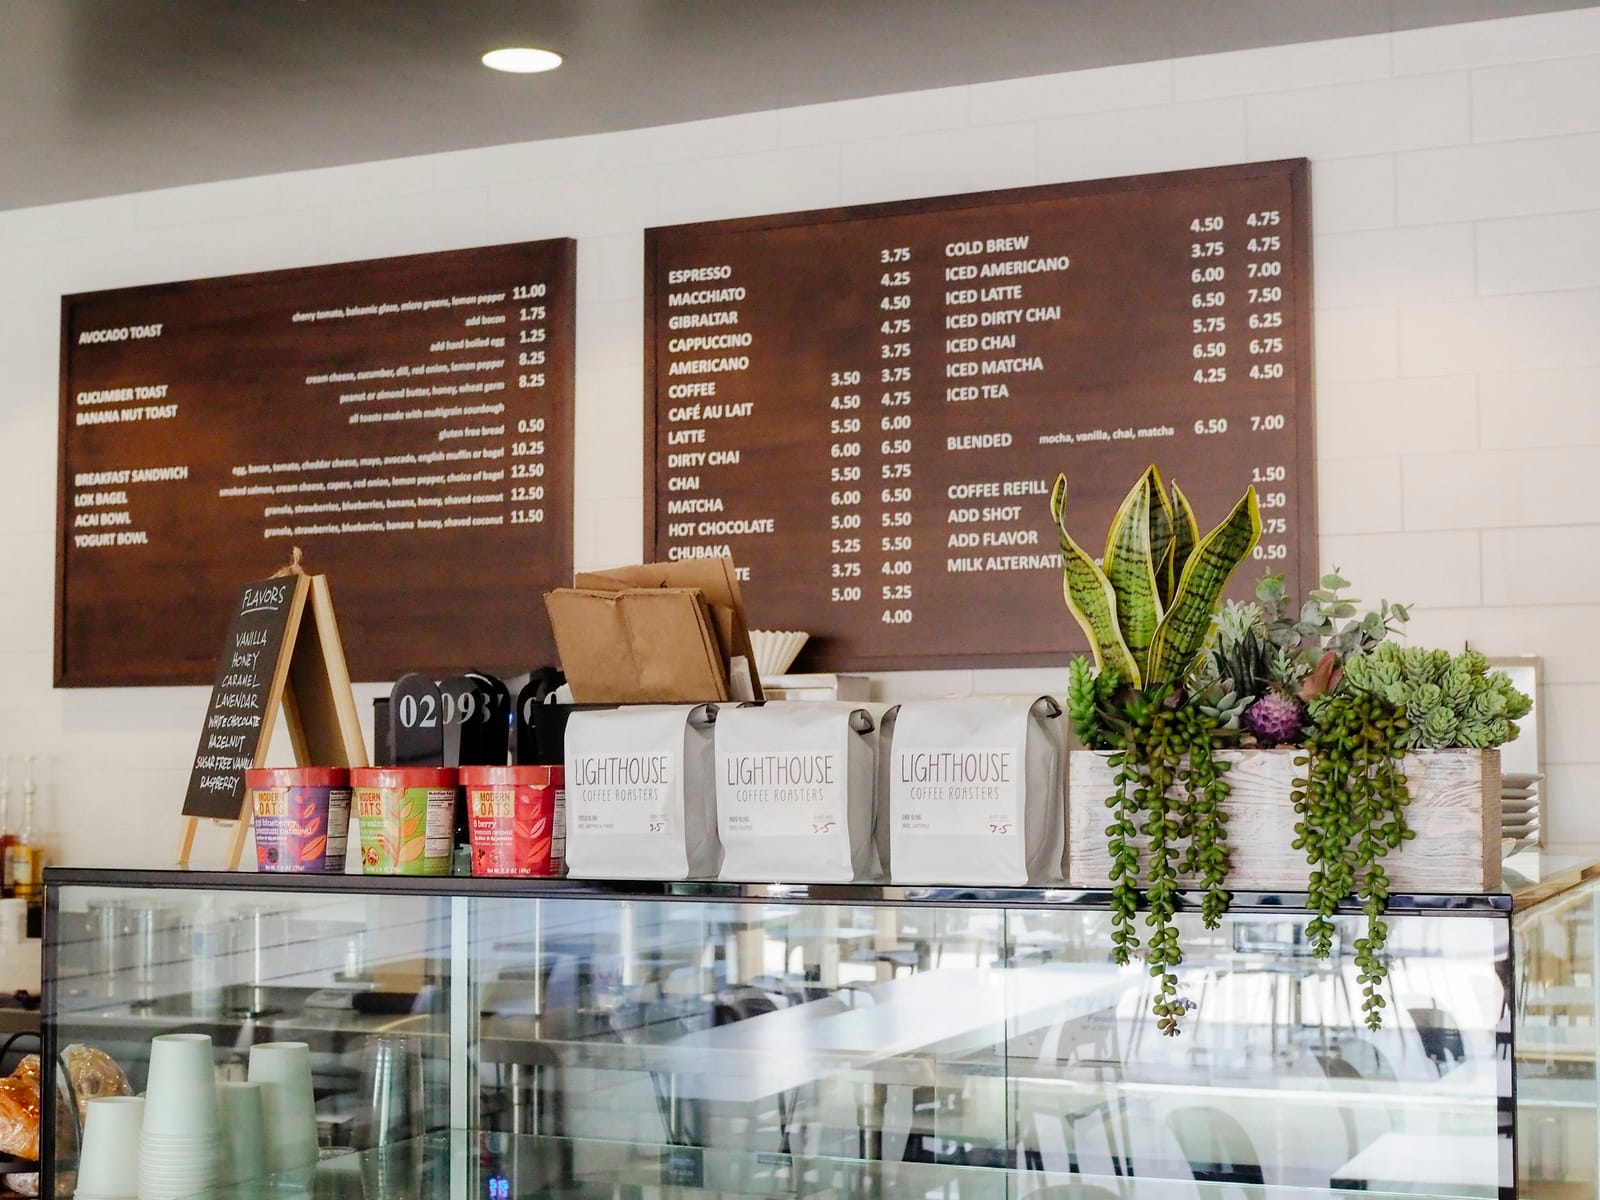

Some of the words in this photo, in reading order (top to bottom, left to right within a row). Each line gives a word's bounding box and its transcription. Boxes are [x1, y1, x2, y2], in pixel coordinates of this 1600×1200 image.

[1191, 217, 1223, 232] 4.50
[1247, 211, 1280, 226] 4.75
[946, 241, 983, 257] COLD
[987, 236, 1029, 253] BREW
[1192, 242, 1224, 257] 3.75
[1247, 236, 1280, 252] 4.75
[881, 248, 910, 263] 3.75
[669, 266, 731, 284] ESPRESSO
[946, 266, 977, 281] ICED
[980, 256, 1069, 277] AMERICANO
[1192, 267, 1224, 282] 6.00
[1248, 262, 1281, 278] 7.00
[881, 272, 910, 286] 4.25
[513, 284, 546, 300] 11.00
[669, 287, 745, 306] MACCHIATO
[946, 290, 977, 305] ICED
[981, 285, 1022, 302] LATTE
[1192, 292, 1225, 308] 6.50
[1248, 287, 1281, 303] 7.50
[520, 306, 545, 321] 1.75
[669, 311, 738, 329] GIBRALTAR
[946, 314, 978, 329] ICED
[981, 309, 1023, 326] DIRTY
[1026, 306, 1060, 322] CHAI
[881, 319, 910, 334] 4.75
[1193, 317, 1225, 333] 5.75
[1249, 312, 1282, 328] 6.25
[79, 328, 129, 344] AVOCADO
[130, 324, 162, 338] TOAST
[520, 329, 545, 343] 1.25
[669, 333, 752, 352] CAPPUCCINO
[882, 343, 911, 358] 3.75
[947, 338, 978, 353] ICED
[981, 335, 1015, 350] CHAI
[1193, 342, 1226, 358] 6.50
[1250, 338, 1283, 354] 6.75
[519, 351, 545, 365] 8.25
[669, 357, 749, 375] AMERICANO
[947, 362, 978, 377] ICED
[982, 357, 1043, 374] MATCHA
[1194, 368, 1226, 383] 4.25
[1250, 363, 1283, 379] 4.50
[519, 374, 545, 388] 8.25
[831, 371, 860, 386] 3.50
[882, 367, 911, 382] 3.75
[77, 388, 136, 405] CUCUMBER
[135, 385, 168, 400] TOAST
[669, 382, 715, 398] COFFEE
[947, 387, 978, 401] ICED
[981, 384, 1009, 398] TEA
[831, 395, 860, 409] 4.50
[881, 391, 911, 406] 4.75
[76, 410, 120, 425] BANANA
[119, 408, 144, 421] NUT
[145, 405, 178, 419] TOAST
[669, 403, 700, 421] CAFÉ
[703, 405, 722, 419] AU
[725, 403, 753, 417] LAIT
[518, 419, 544, 433] 0.50
[831, 419, 860, 433] 5.50
[881, 415, 911, 430] 6.00
[947, 433, 1012, 450] BLENDED
[1039, 433, 1074, 444] mocha,
[1076, 430, 1111, 441] vanilla,
[1113, 428, 1136, 439] chai,
[1138, 426, 1174, 437] matcha
[1195, 419, 1227, 434] 6.50
[1251, 415, 1284, 430] 7.00
[668, 429, 705, 444] LATTE
[512, 441, 544, 456] 10.25
[831, 443, 860, 457] 6.00
[882, 440, 911, 454] 6.50
[668, 453, 706, 467] DIRTY
[708, 451, 739, 465] CHAI
[75, 470, 130, 486] BREAKFAST
[132, 466, 188, 482] SANDWICH
[512, 463, 544, 478] 12.50
[832, 467, 860, 481] 5.50
[882, 464, 911, 478] 5.75
[1252, 466, 1285, 482] 1.50
[668, 476, 699, 491] CHAI
[948, 483, 1000, 499] COFFEE
[1004, 480, 1048, 496] REFILL
[75, 494, 94, 507] LOX
[95, 491, 128, 505] BAGEL
[511, 486, 543, 501] 12.50
[831, 491, 860, 505] 6.00
[882, 488, 911, 502] 6.50
[668, 498, 723, 514] MATCHA
[948, 509, 979, 523] ADD
[983, 506, 1021, 521] SHOT
[75, 514, 99, 527] ACAI
[100, 512, 131, 525] BOWL
[511, 509, 543, 523] 11.50
[832, 515, 861, 529] 5.00
[882, 512, 911, 526] 5.50
[669, 523, 696, 536] HOT
[698, 519, 774, 535] CHOCOLATE
[75, 533, 118, 547] YOGURT
[117, 532, 148, 545] BOWL
[832, 539, 861, 553] 5.25
[882, 537, 911, 551] 5.50
[948, 533, 979, 547] ADD
[983, 531, 1038, 546] FLAVOR
[668, 545, 731, 560] CHUBAKA
[1253, 544, 1287, 560] 0.50
[832, 563, 861, 577] 3.75
[882, 561, 912, 575] 4.00
[947, 557, 983, 573] MILK
[985, 553, 1065, 571] ALTERNATI
[241, 585, 286, 609] FLAVORS
[832, 587, 861, 601] 5.00
[883, 585, 912, 599] 5.25
[882, 610, 912, 623] 4.00
[237, 630, 267, 647] VANILLA
[232, 651, 260, 671] HONEY
[222, 674, 260, 688] CARAMEL
[399, 694, 437, 728] 02
[208, 734, 246, 752] HAZELNUT
[195, 755, 215, 769] SUGAR
[215, 756, 232, 771] FREE
[575, 757, 668, 785] LIGHTHOUSE
[728, 756, 834, 786] LIGHTHOUSE
[902, 753, 1009, 783] LIGHTHOUSE
[200, 776, 240, 797] RASPBERRY
[583, 789, 611, 802] COFFEE
[616, 788, 657, 801] ROASTERS
[737, 789, 768, 802] COFFEE
[774, 788, 824, 802] ROASTERS
[911, 787, 943, 800] COFFEE
[949, 786, 998, 800] ROASTERS
[480, 792, 510, 802] MODERN
[259, 802, 285, 815] OATS
[480, 803, 510, 816] OATS
